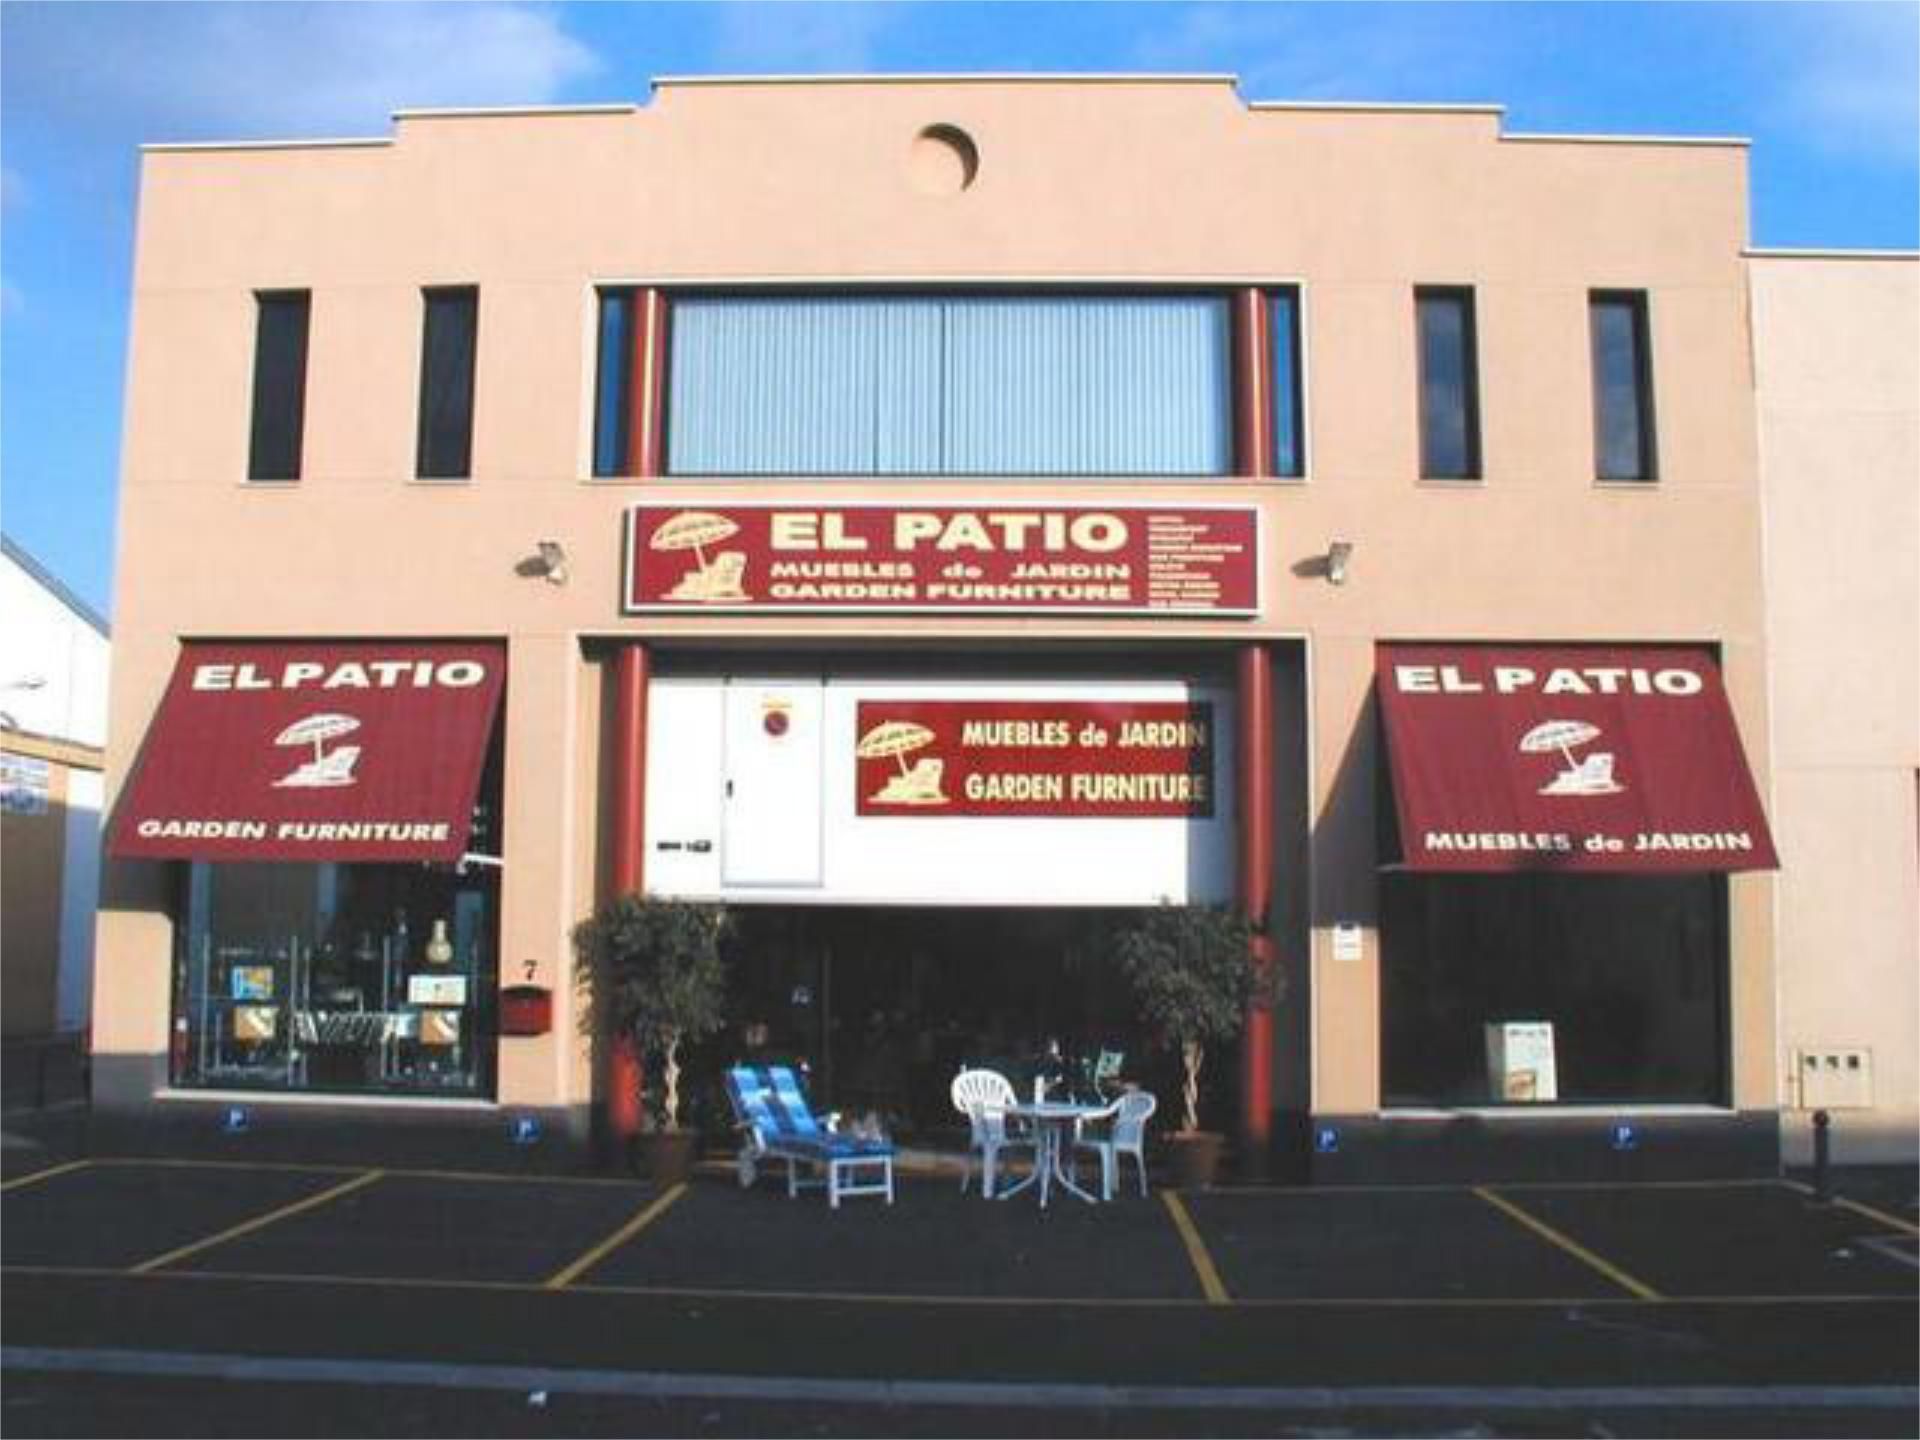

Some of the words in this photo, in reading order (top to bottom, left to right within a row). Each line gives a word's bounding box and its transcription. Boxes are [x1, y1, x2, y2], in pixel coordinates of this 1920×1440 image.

[771, 512, 868, 550] EL
[895, 512, 1128, 552] PATIO
[770, 562, 914, 577] MUEBLES
[942, 562, 983, 578] de
[1012, 563, 1130, 579] JARDIN
[770, 583, 916, 599] GARDEN
[927, 583, 1130, 600] FURNITURE
[192, 665, 271, 690] EL
[281, 661, 486, 688] PATIO
[1394, 665, 1482, 692] EL
[1495, 667, 1703, 694] PATIO
[962, 721, 1070, 746] MUEBLES
[1079, 722, 1108, 747] de
[1118, 721, 1206, 747] JARDIN
[965, 774, 1062, 800] GARDEN
[1071, 774, 1207, 801] FURNITURE
[138, 821, 266, 838] GARDEN
[278, 823, 449, 841] FURNITURE
[1425, 832, 1570, 850] MUEBLES
[1584, 834, 1624, 851] de
[1634, 833, 1752, 850] JARDIN
[523, 959, 538, 981] 7
